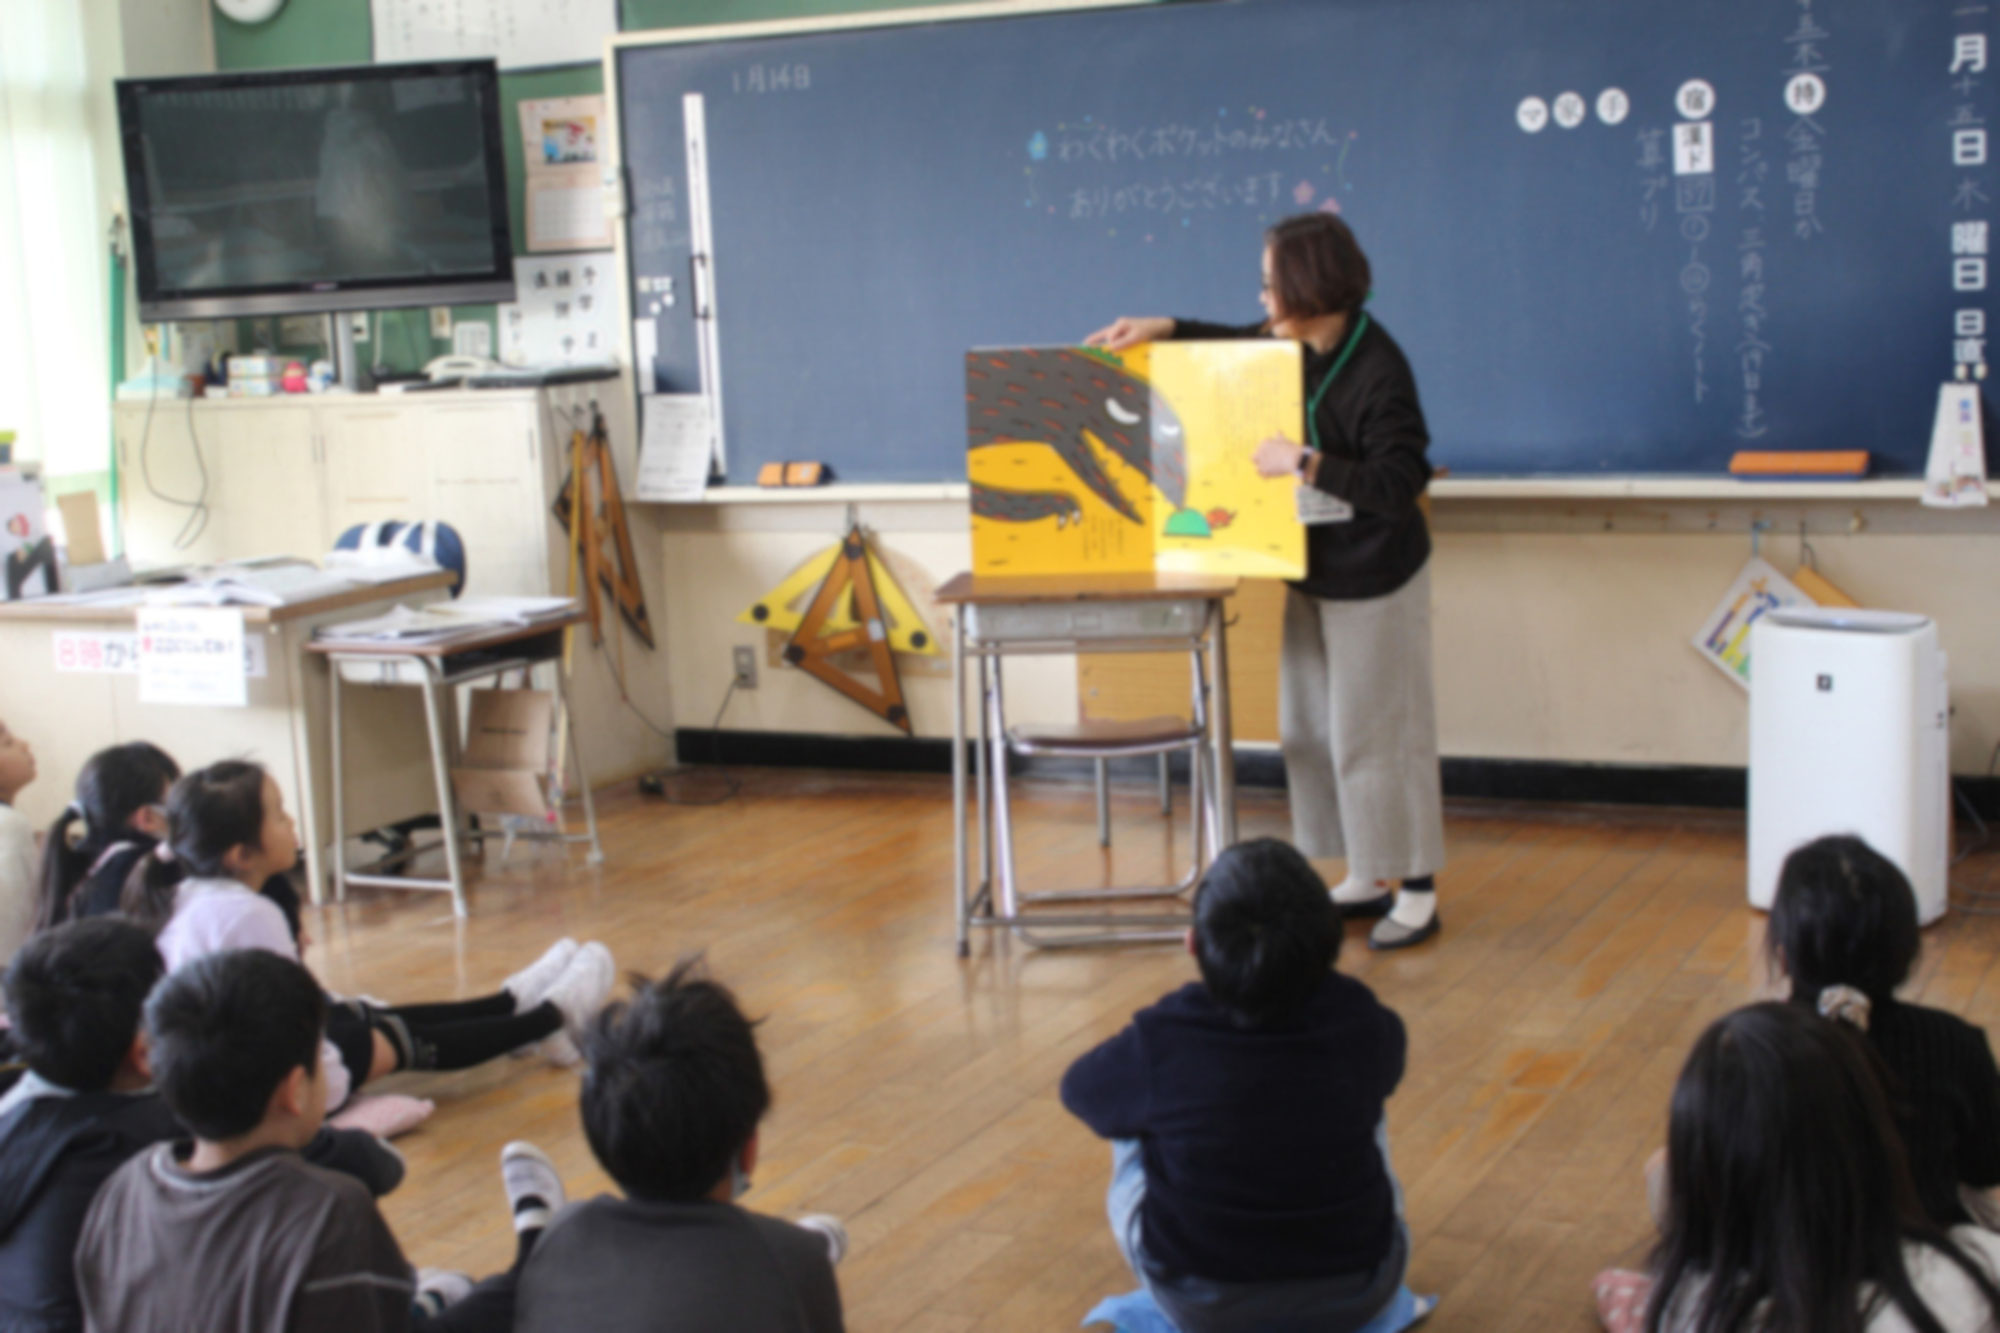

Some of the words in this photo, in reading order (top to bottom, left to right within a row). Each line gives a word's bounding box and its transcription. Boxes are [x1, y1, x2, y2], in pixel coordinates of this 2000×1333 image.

[731, 63, 812, 95] 1月14日
[1057, 116, 1338, 161] わくわくポケットのみなさん
[1068, 169, 1286, 220] ありがとうございます
